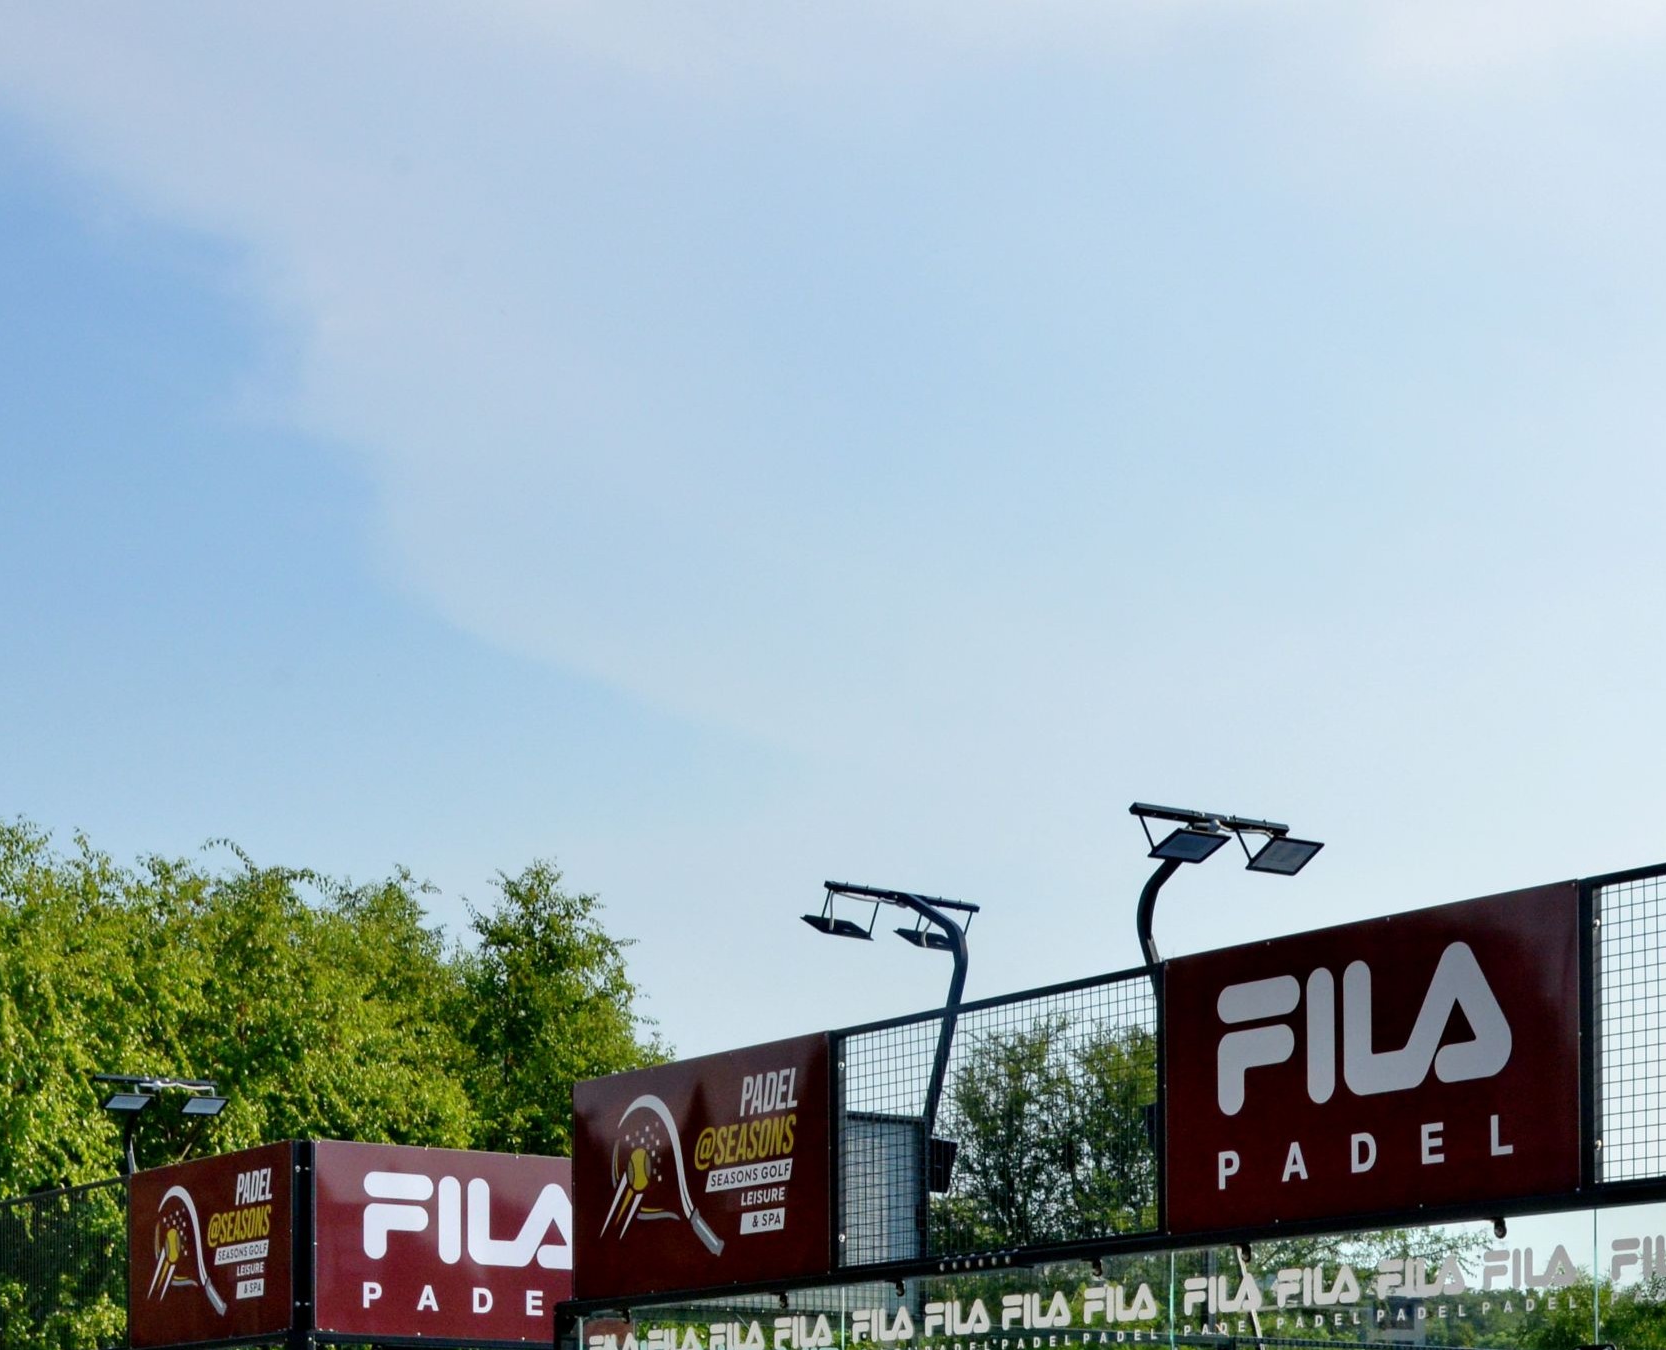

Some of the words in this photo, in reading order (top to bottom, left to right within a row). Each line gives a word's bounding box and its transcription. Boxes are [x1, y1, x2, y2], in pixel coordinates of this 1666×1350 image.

[1217, 941, 1512, 1116] FILA
[740, 1067, 798, 1117] PADEL
[694, 1114, 797, 1171] @SEASONS
[1218, 1114, 1513, 1190] PADEL
[235, 1168, 272, 1206] PADEL
[711, 1167, 758, 1187] SEASONS
[761, 1162, 790, 1179] GOLF
[740, 1187, 785, 1206] LEISURE
[207, 1204, 271, 1248] @SEASONS
[363, 1171, 573, 1270] FILA
[752, 1215, 758, 1228] &
[762, 1211, 781, 1226] SPA
[218, 1247, 248, 1261] SEASONS
[249, 1243, 267, 1255] GOLF
[237, 1262, 264, 1277] LEISURE
[249, 1283, 261, 1293] SPA
[363, 1281, 544, 1317] PADE
[774, 1314, 832, 1349] FILA
[852, 1306, 914, 1344] FILA
[925, 1298, 991, 1337] FILA
[1002, 1291, 1071, 1331] FILA
[1083, 1283, 1157, 1325] FILA
[1184, 1272, 1263, 1316] FILA
[1276, 1265, 1360, 1309] FILA
[1377, 1254, 1466, 1300] FILA
[1483, 1244, 1577, 1291] FILA
[1001, 1334, 1071, 1350] PADEL
[1083, 1329, 1158, 1345] PADEL
[1277, 1313, 1360, 1330] PADEL
[1377, 1303, 1466, 1322] PADEL
[1482, 1296, 1578, 1315] PADEL
